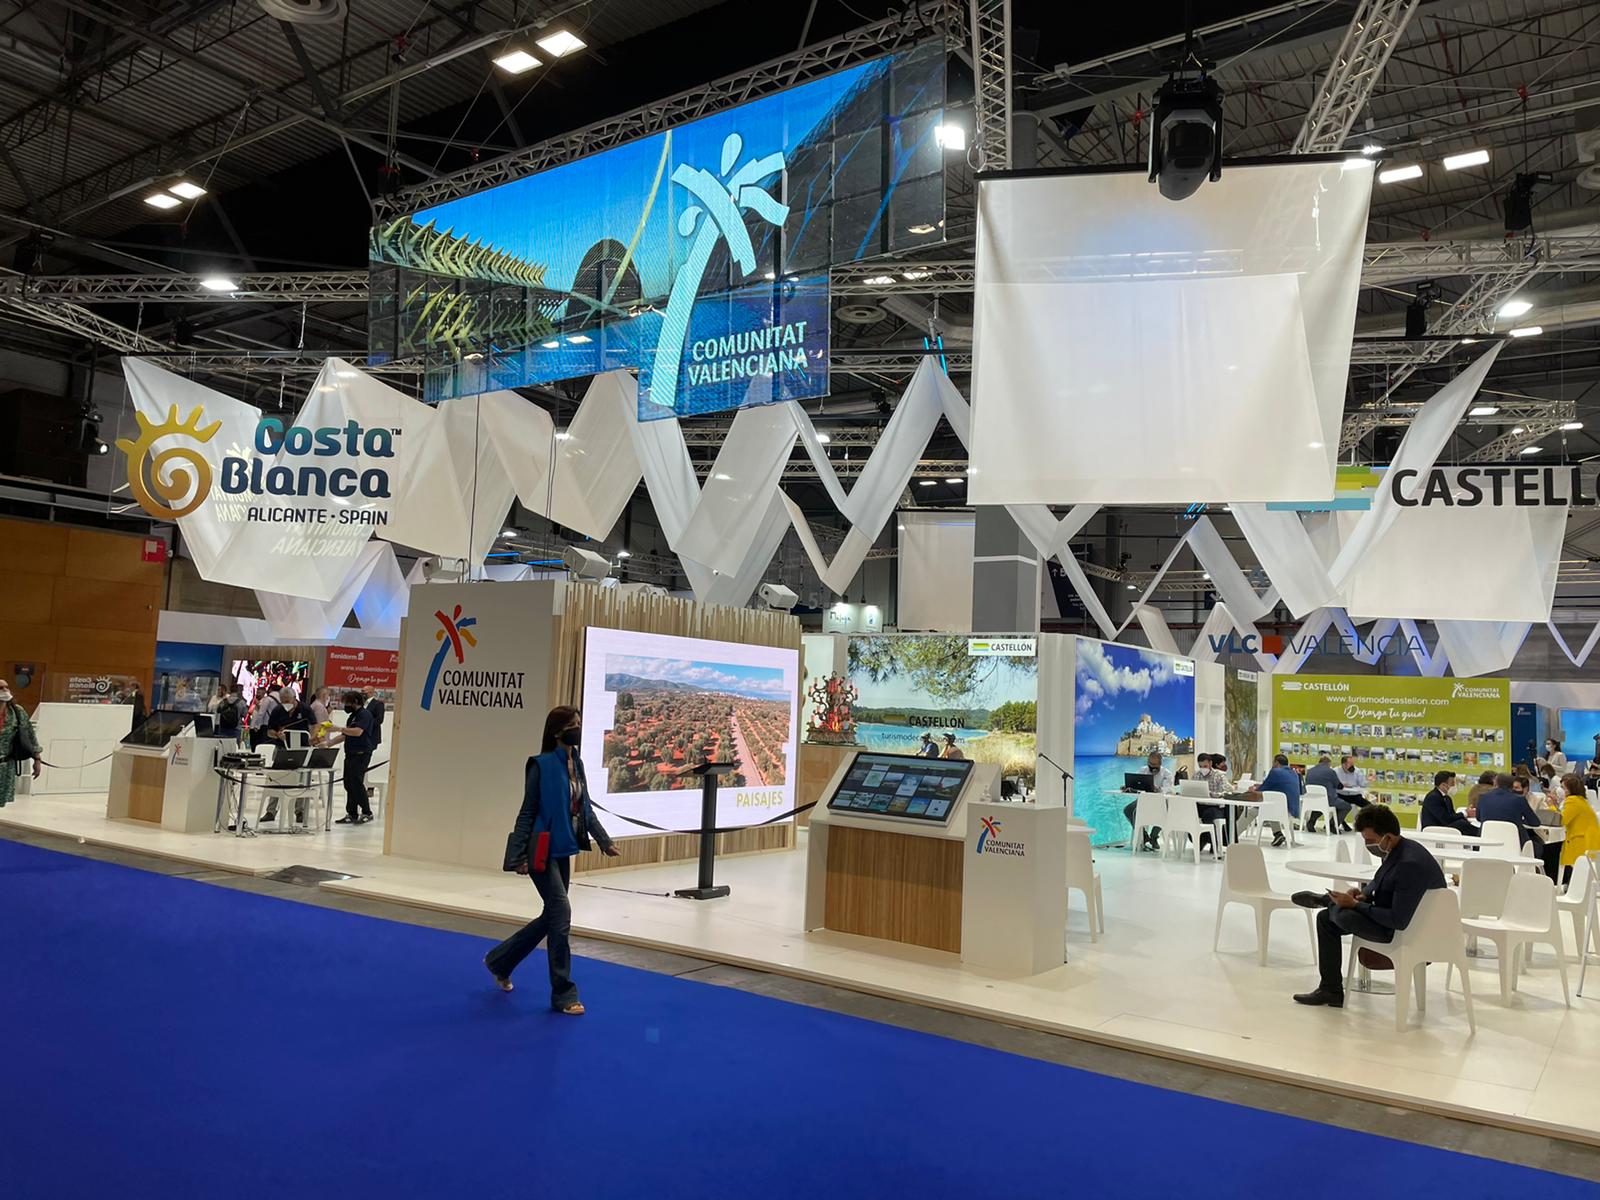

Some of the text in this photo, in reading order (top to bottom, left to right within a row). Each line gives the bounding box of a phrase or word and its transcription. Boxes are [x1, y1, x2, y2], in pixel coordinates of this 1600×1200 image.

[692, 321, 807, 362] COMUNITAT
[687, 346, 809, 386] VALENCIANA
[255, 417, 395, 458] Costa
[220, 456, 391, 498] Blanca
[1391, 468, 1600, 507] CASTELL
[247, 507, 388, 525] ALICANTE SPAIN
[990, 642, 1033, 651] CASTELLÓN
[1208, 629, 1425, 656] VLC VALÈNCIA
[443, 670, 525, 689] COMUNITAT
[1303, 682, 1350, 692] CASTELLÓN
[438, 689, 524, 709] VALENCIANA
[1326, 695, 1449, 706] www.turismodecastellon.com
[908, 714, 966, 729] CASTELLÓN
[736, 791, 785, 809] PAISAJES
[984, 847, 1025, 857] VALENCIANA
[985, 840, 1025, 850] COMUNITAT
